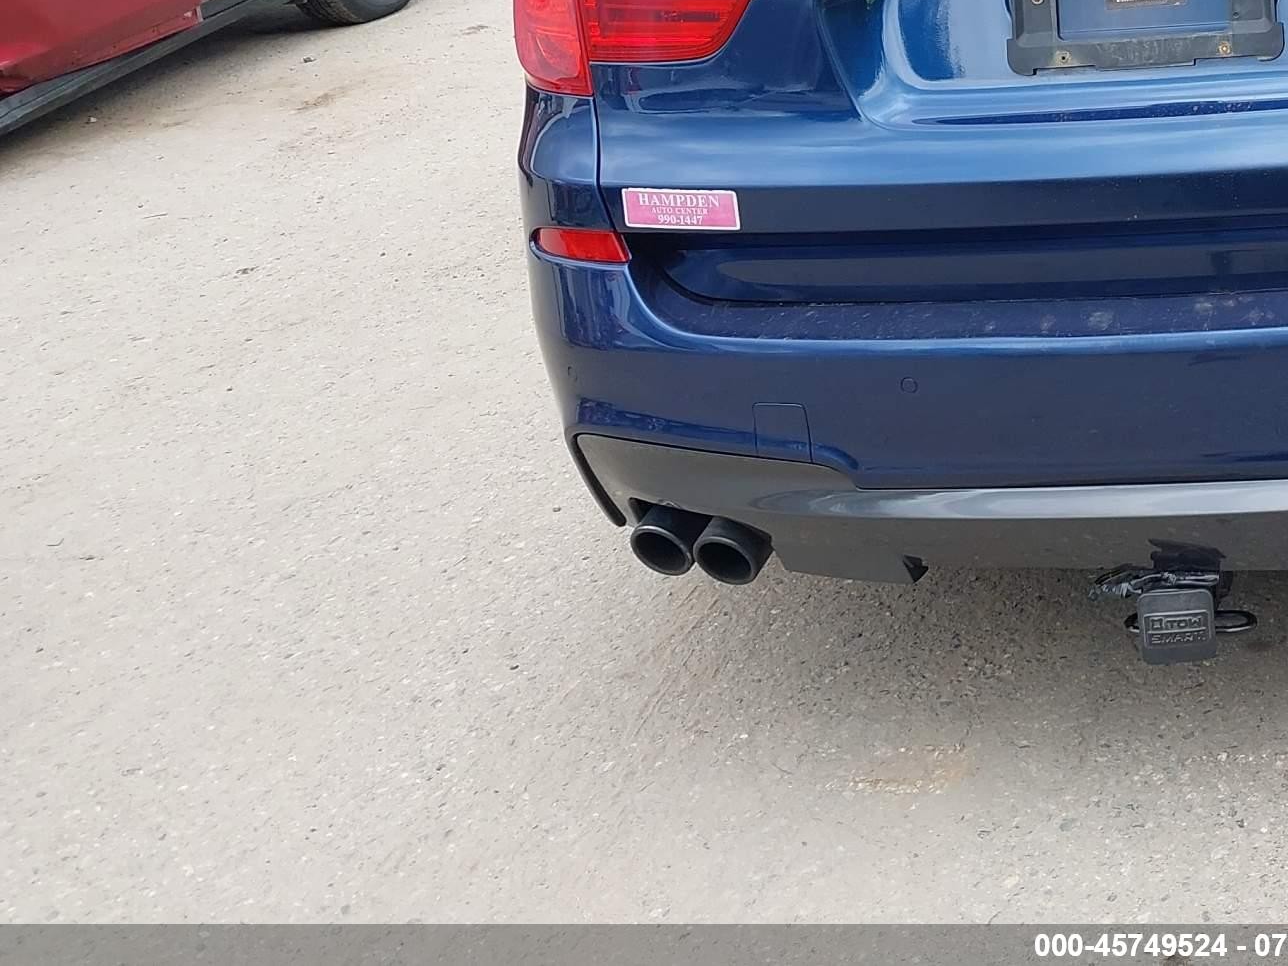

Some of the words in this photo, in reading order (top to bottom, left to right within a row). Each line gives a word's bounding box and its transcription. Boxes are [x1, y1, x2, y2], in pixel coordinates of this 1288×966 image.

[638, 193, 720, 208] HAMPDEN
[675, 207, 708, 215] CENTER
[658, 214, 703, 225] 990-1447
